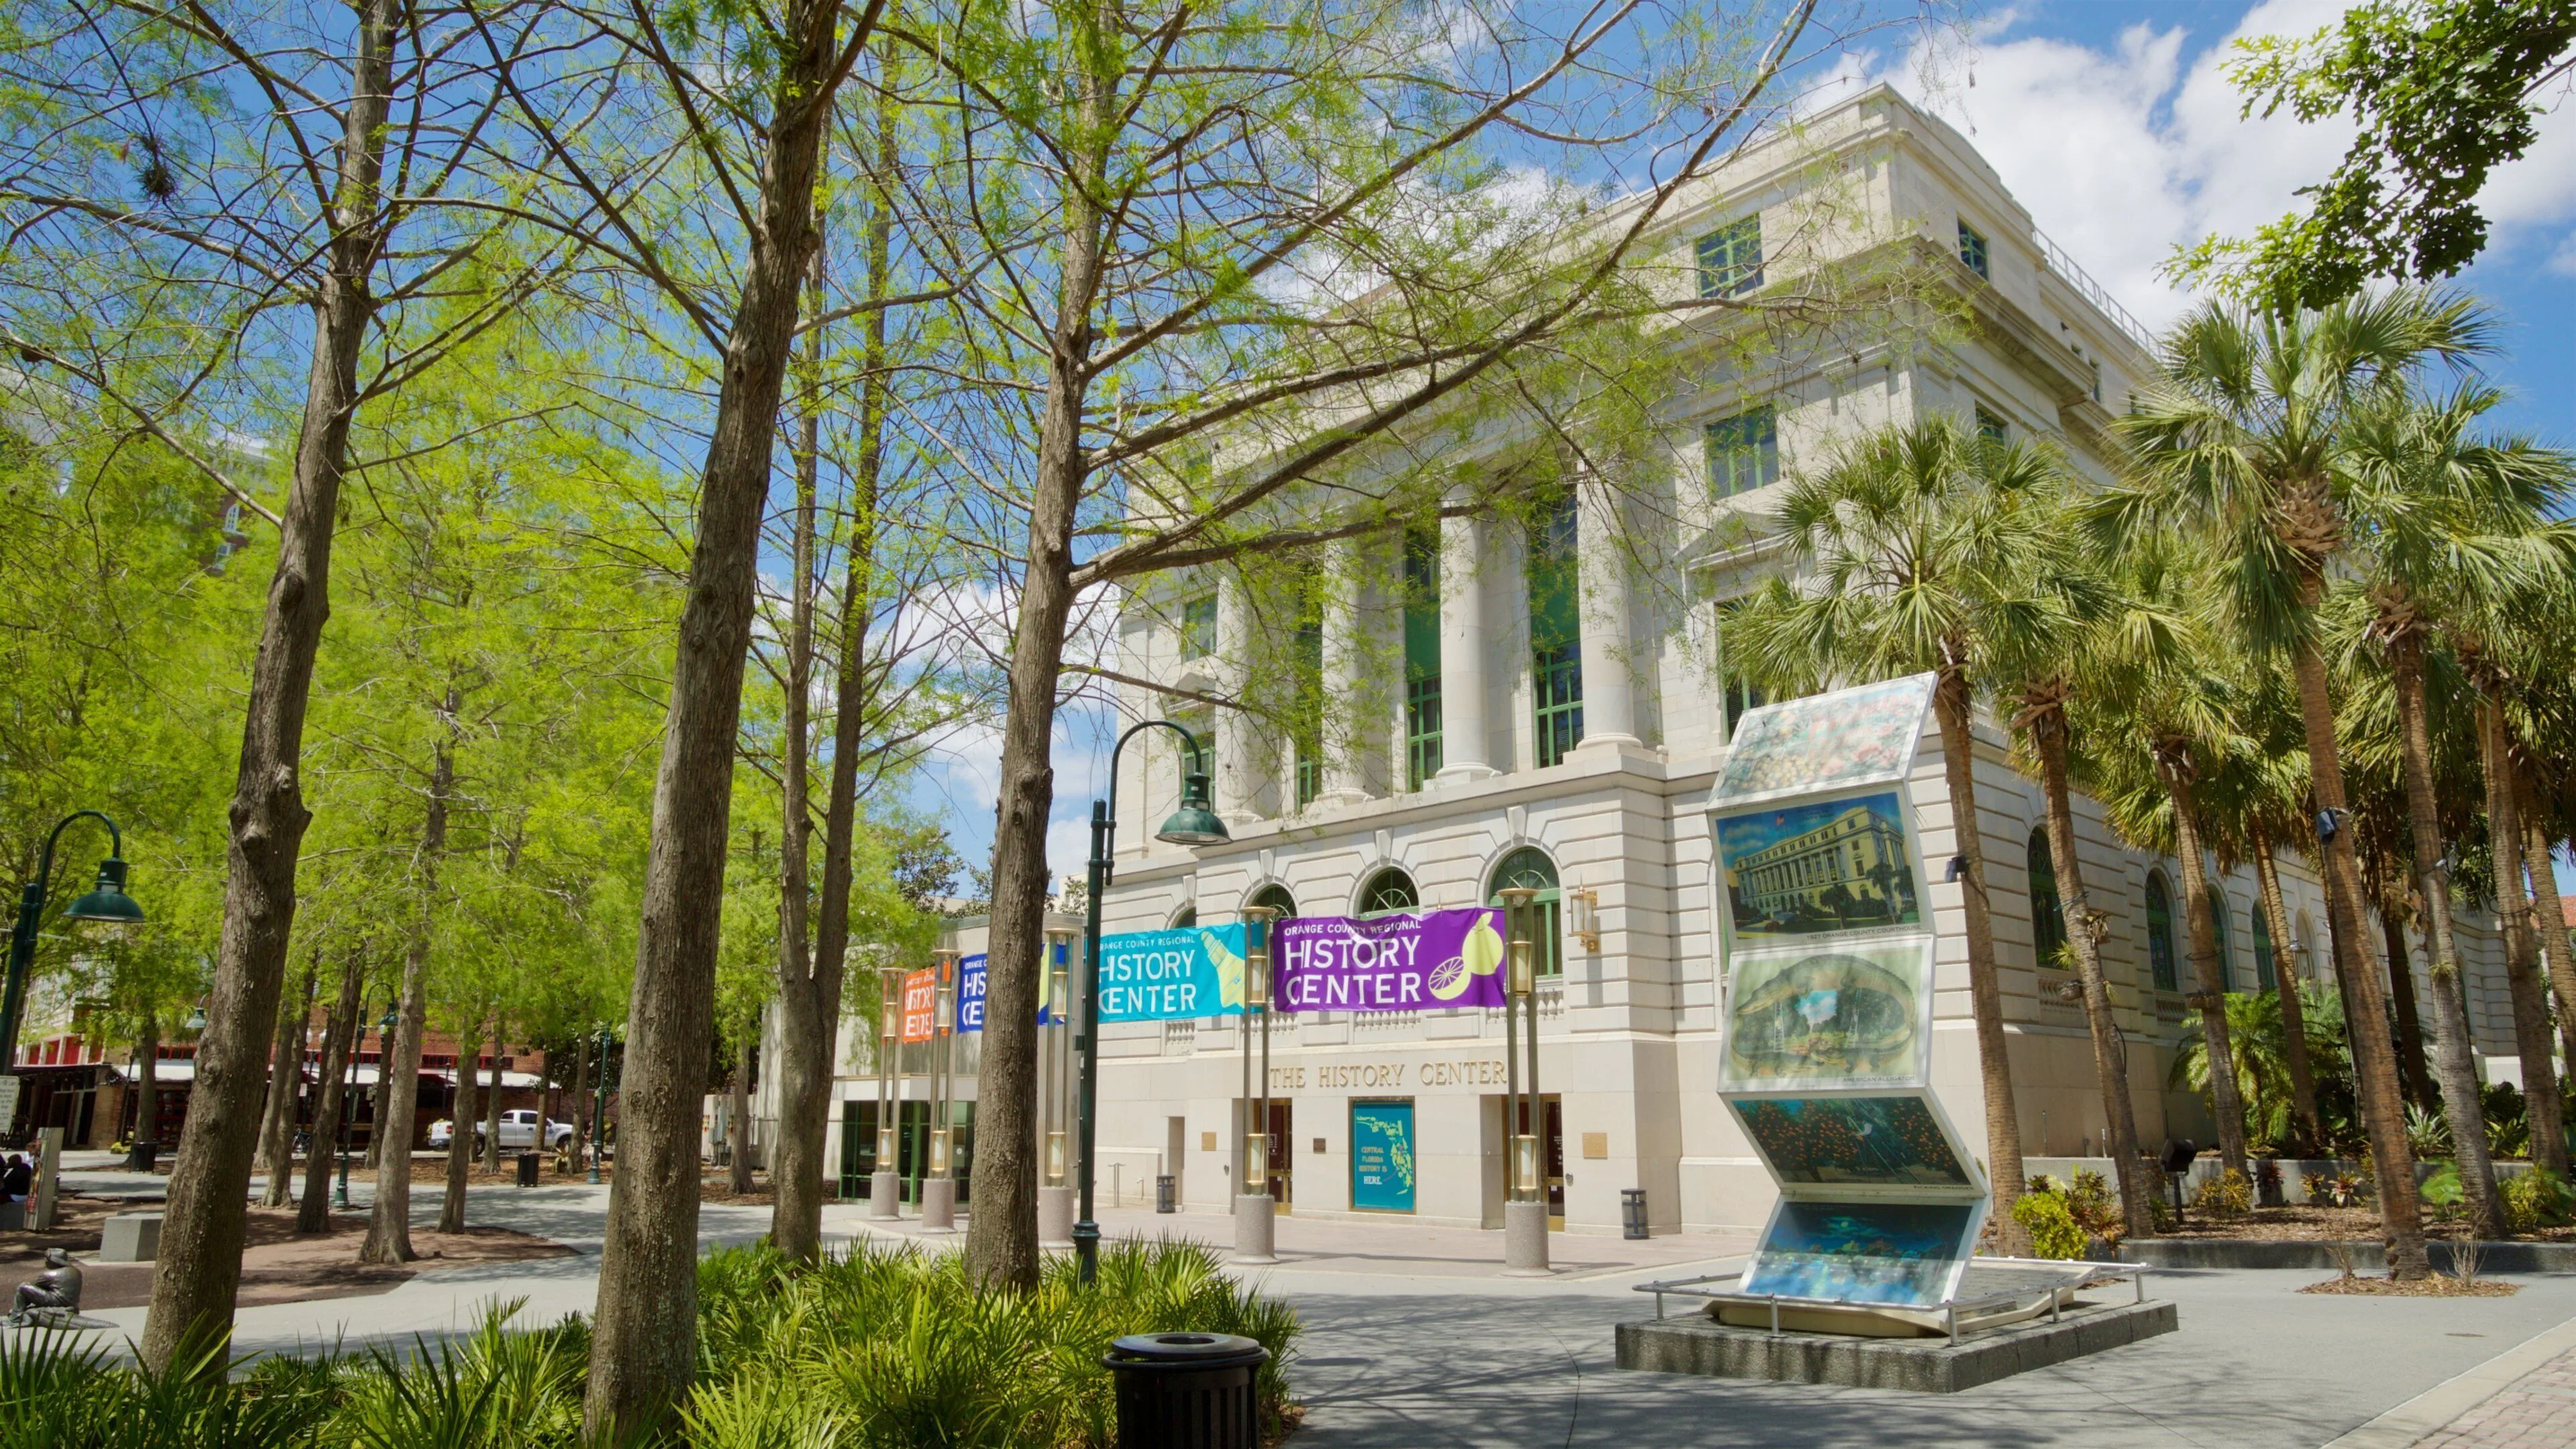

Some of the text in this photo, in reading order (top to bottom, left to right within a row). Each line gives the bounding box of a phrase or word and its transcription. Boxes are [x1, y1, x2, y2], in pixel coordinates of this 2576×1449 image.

[1285, 920, 1421, 936] ORANGE COUNTY REGIONAL
[1877, 924, 1921, 933] COURTHOUSE
[1100, 936, 1195, 951] RANGE COUNTY REGIONAL
[1285, 935, 1421, 971] HISTORY
[1098, 983, 1196, 1014] CENTER
[1286, 972, 1421, 1006] CENTER
[1270, 1059, 1507, 1089] THE HISTORY CENTER
